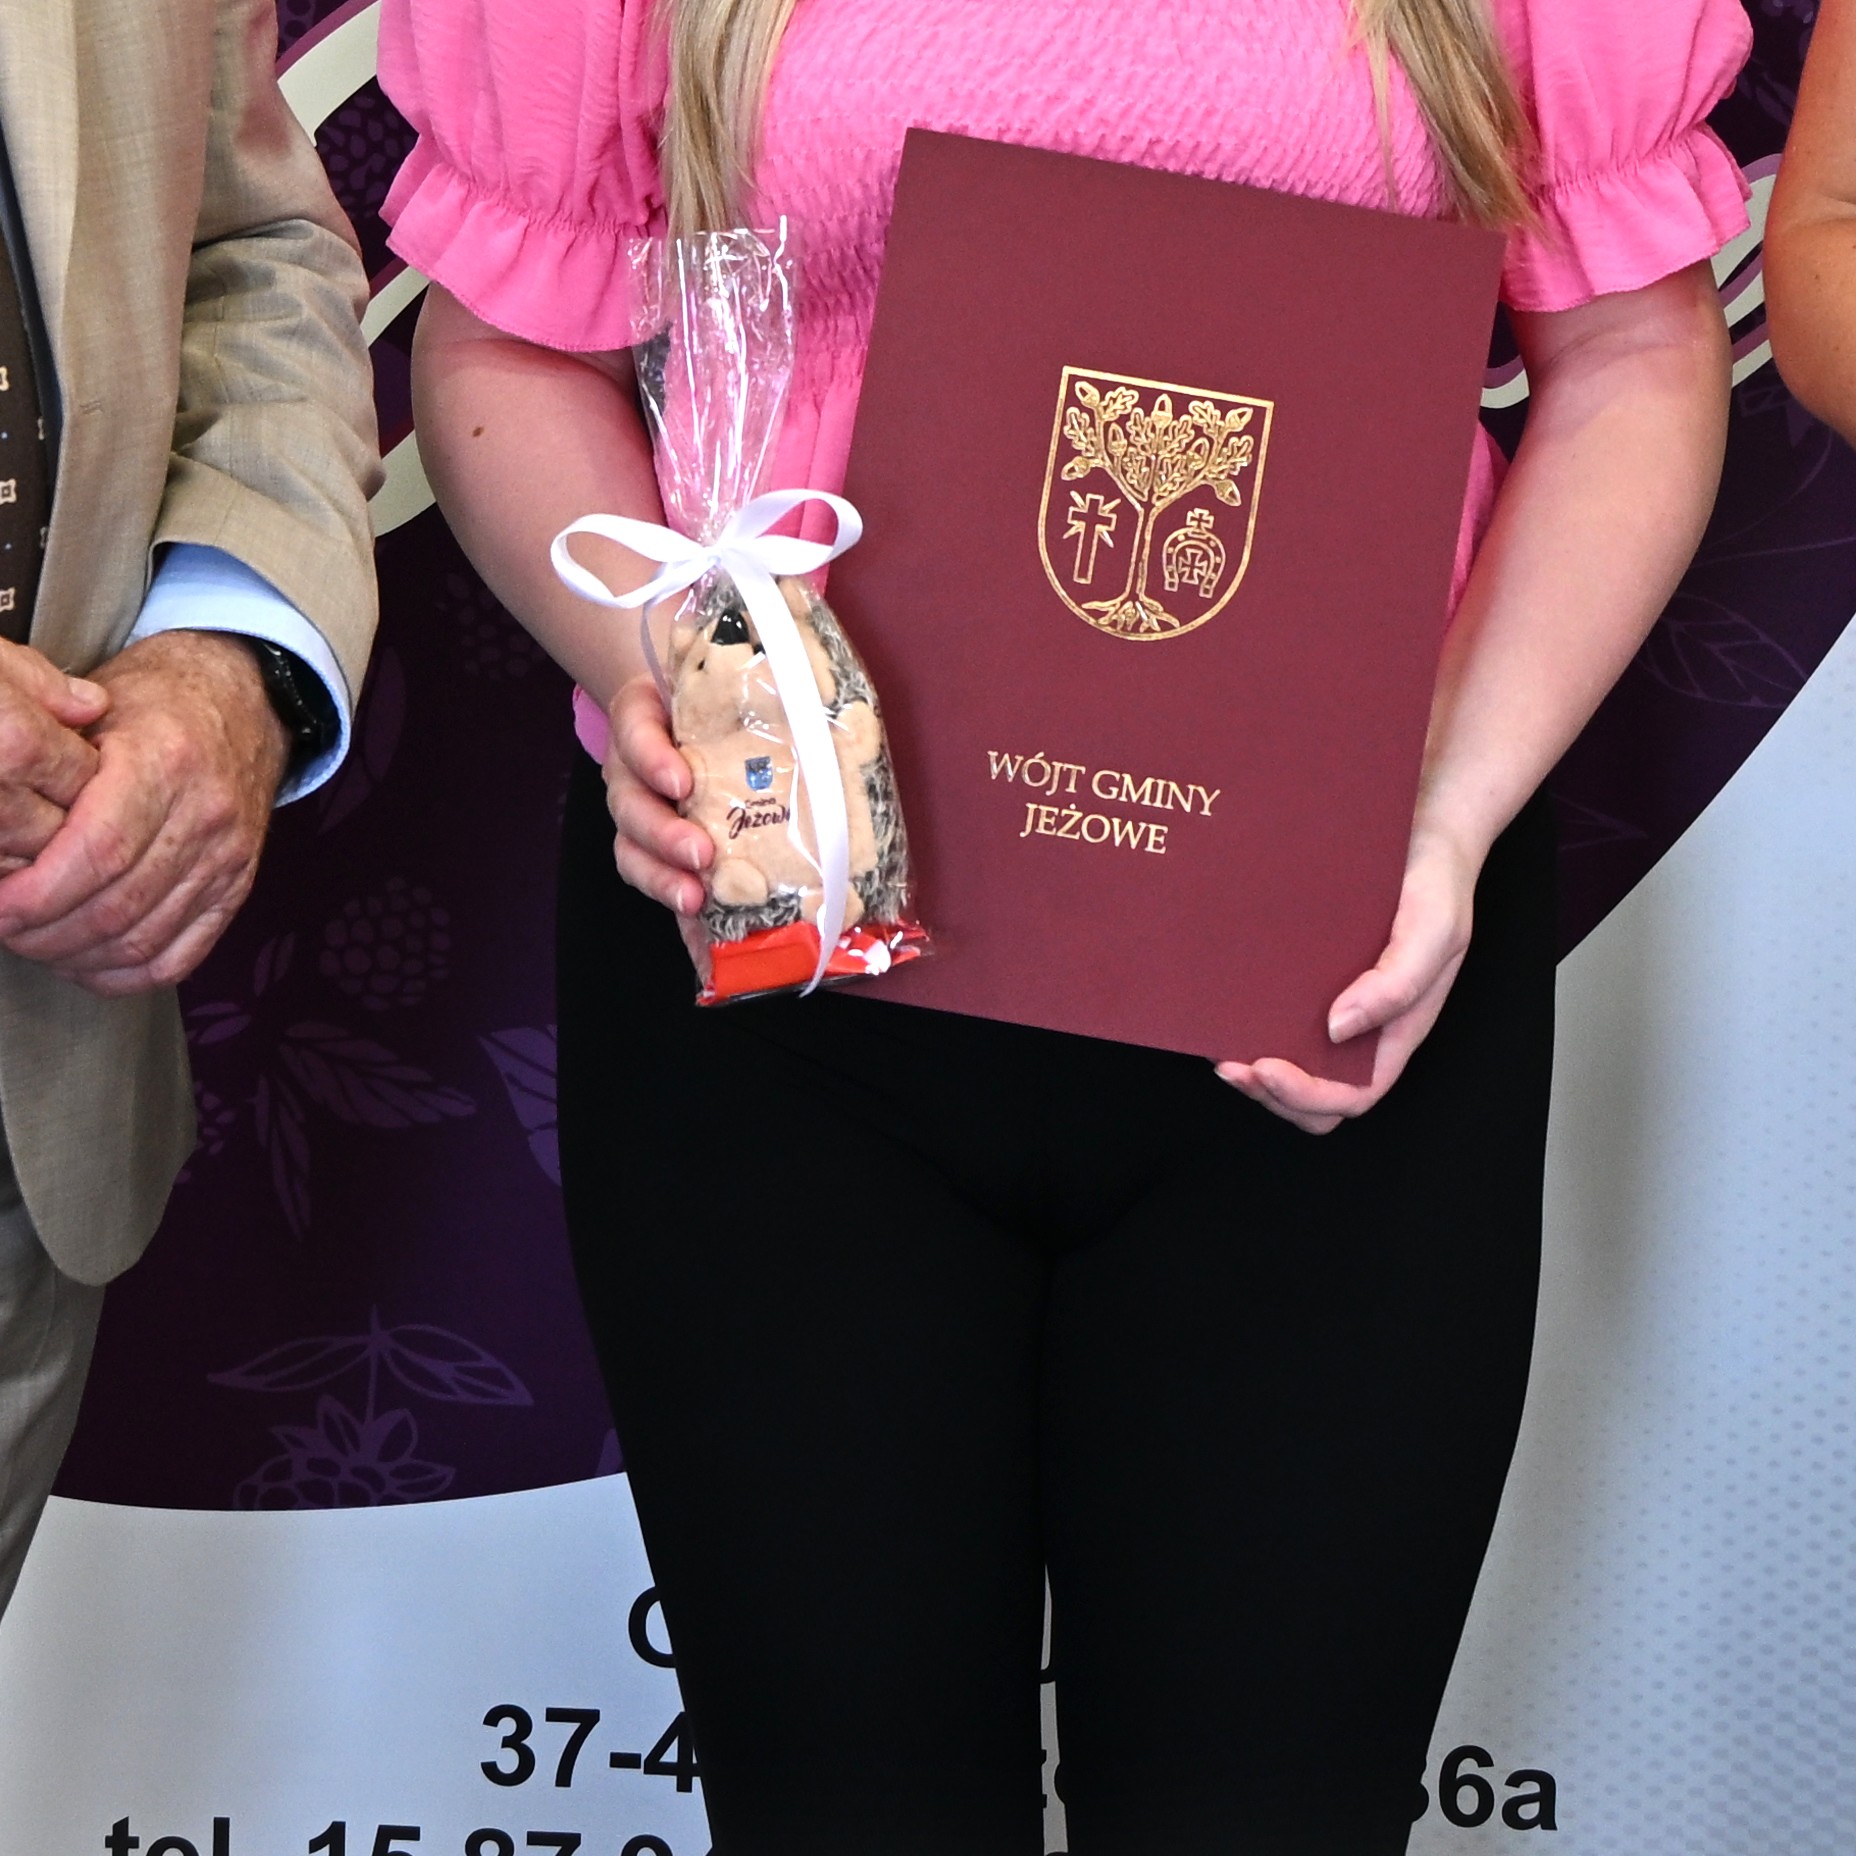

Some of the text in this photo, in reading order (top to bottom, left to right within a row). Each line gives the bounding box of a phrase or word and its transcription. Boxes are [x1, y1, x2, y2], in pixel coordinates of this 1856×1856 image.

[987, 750, 1221, 817] WÓJT GMINY
[1020, 802, 1169, 855] JEŻOWE
[479, 1703, 1559, 1832] 37-4 6a
